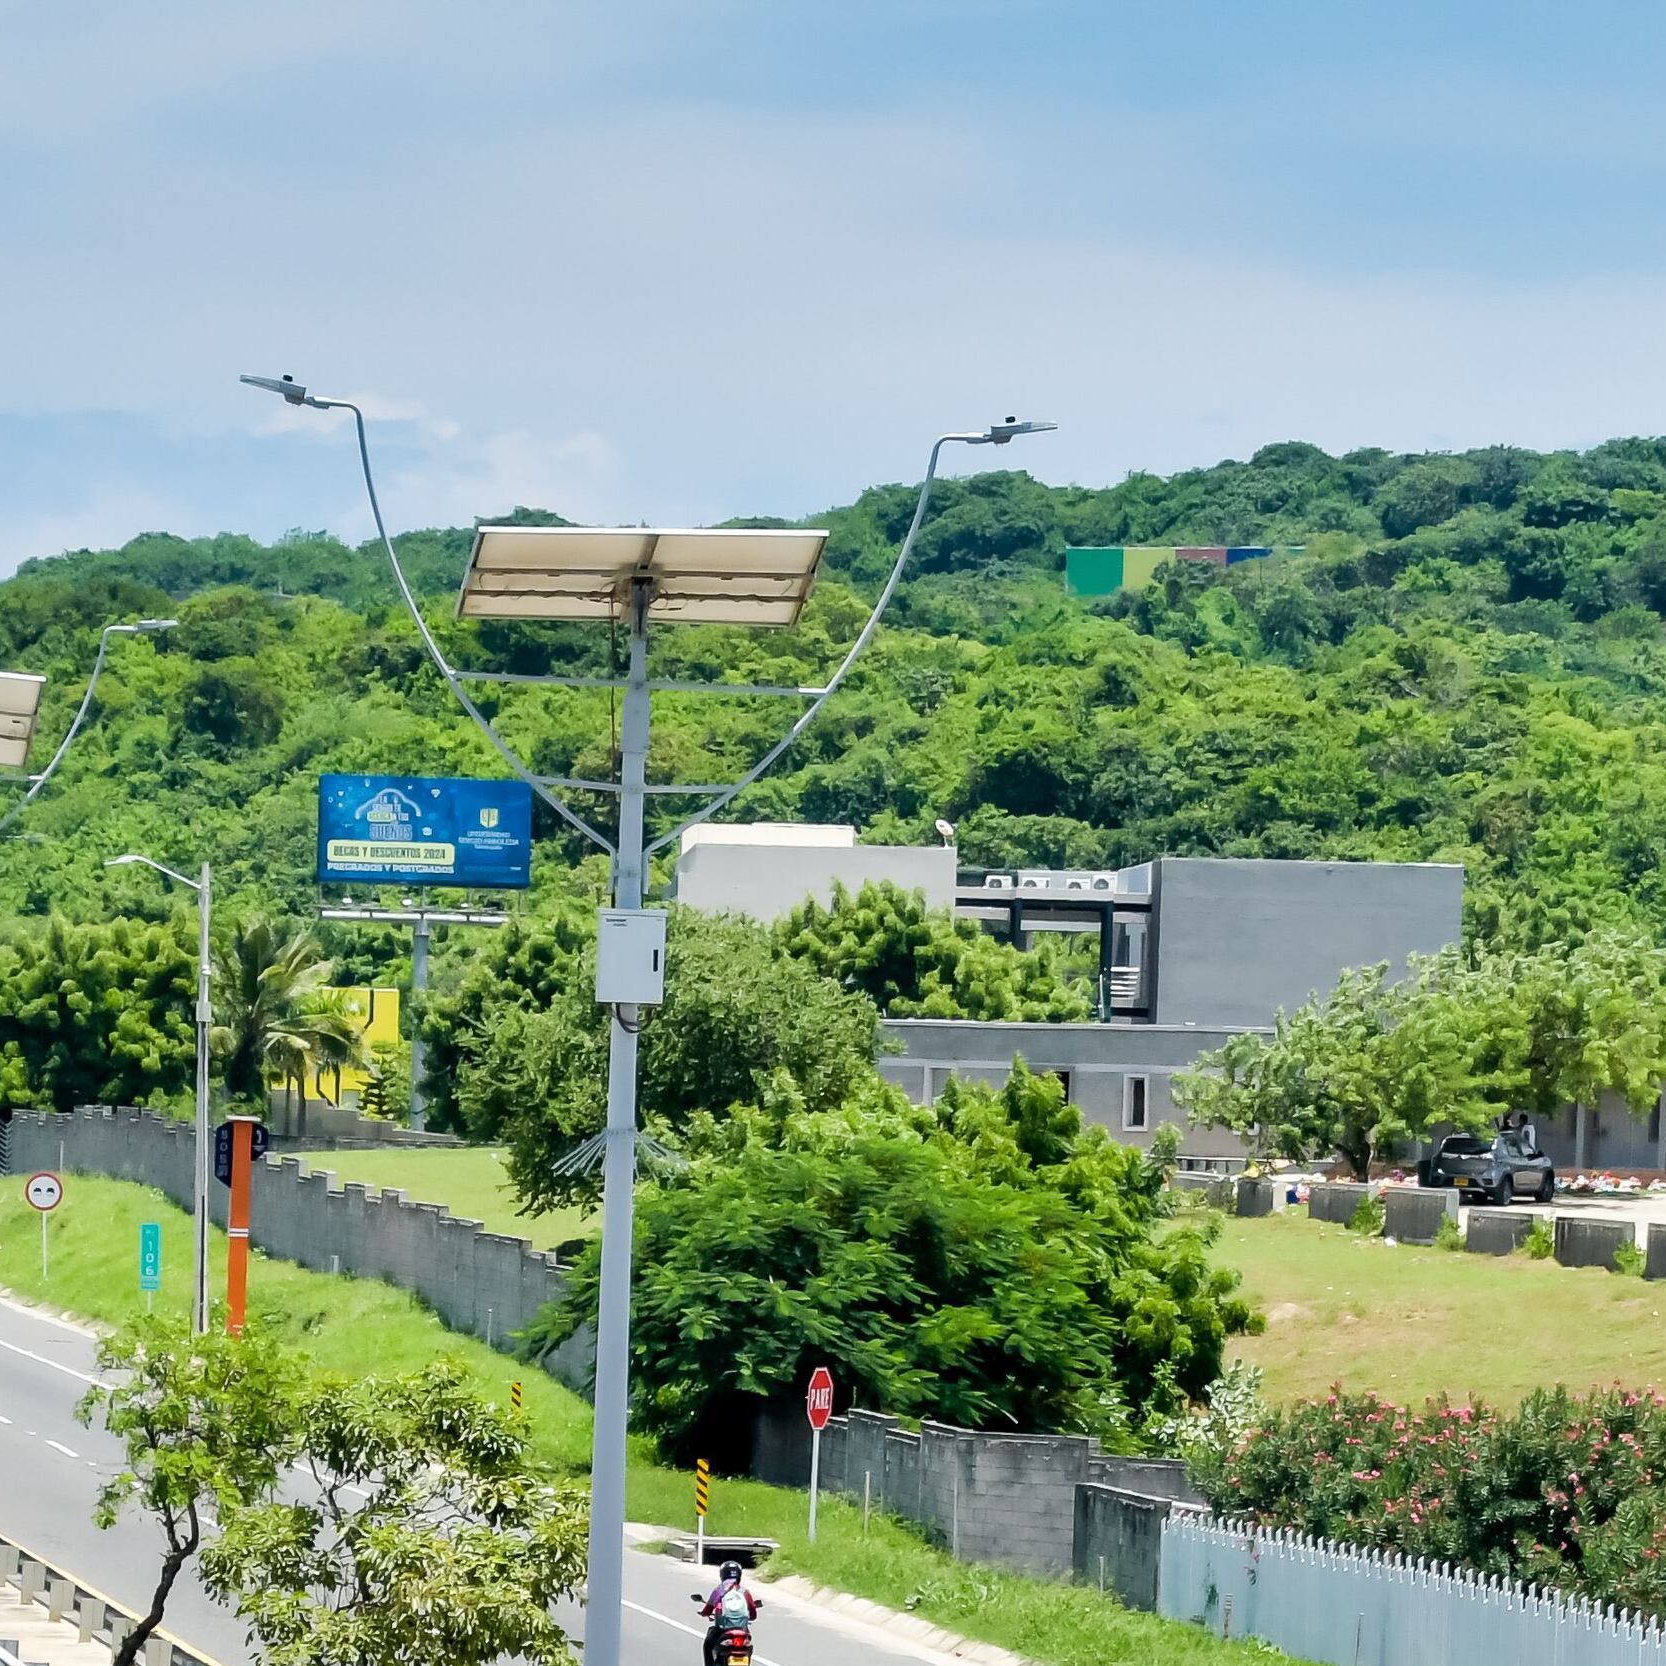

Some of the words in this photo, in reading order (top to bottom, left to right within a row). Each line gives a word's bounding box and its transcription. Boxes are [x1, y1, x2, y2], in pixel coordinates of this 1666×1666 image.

[333, 845, 359, 856] BECAS
[362, 847, 368, 857] Y
[370, 847, 421, 858] DESCUENTOS
[423, 848, 445, 859] 2024
[810, 1387, 830, 1410] PARE
